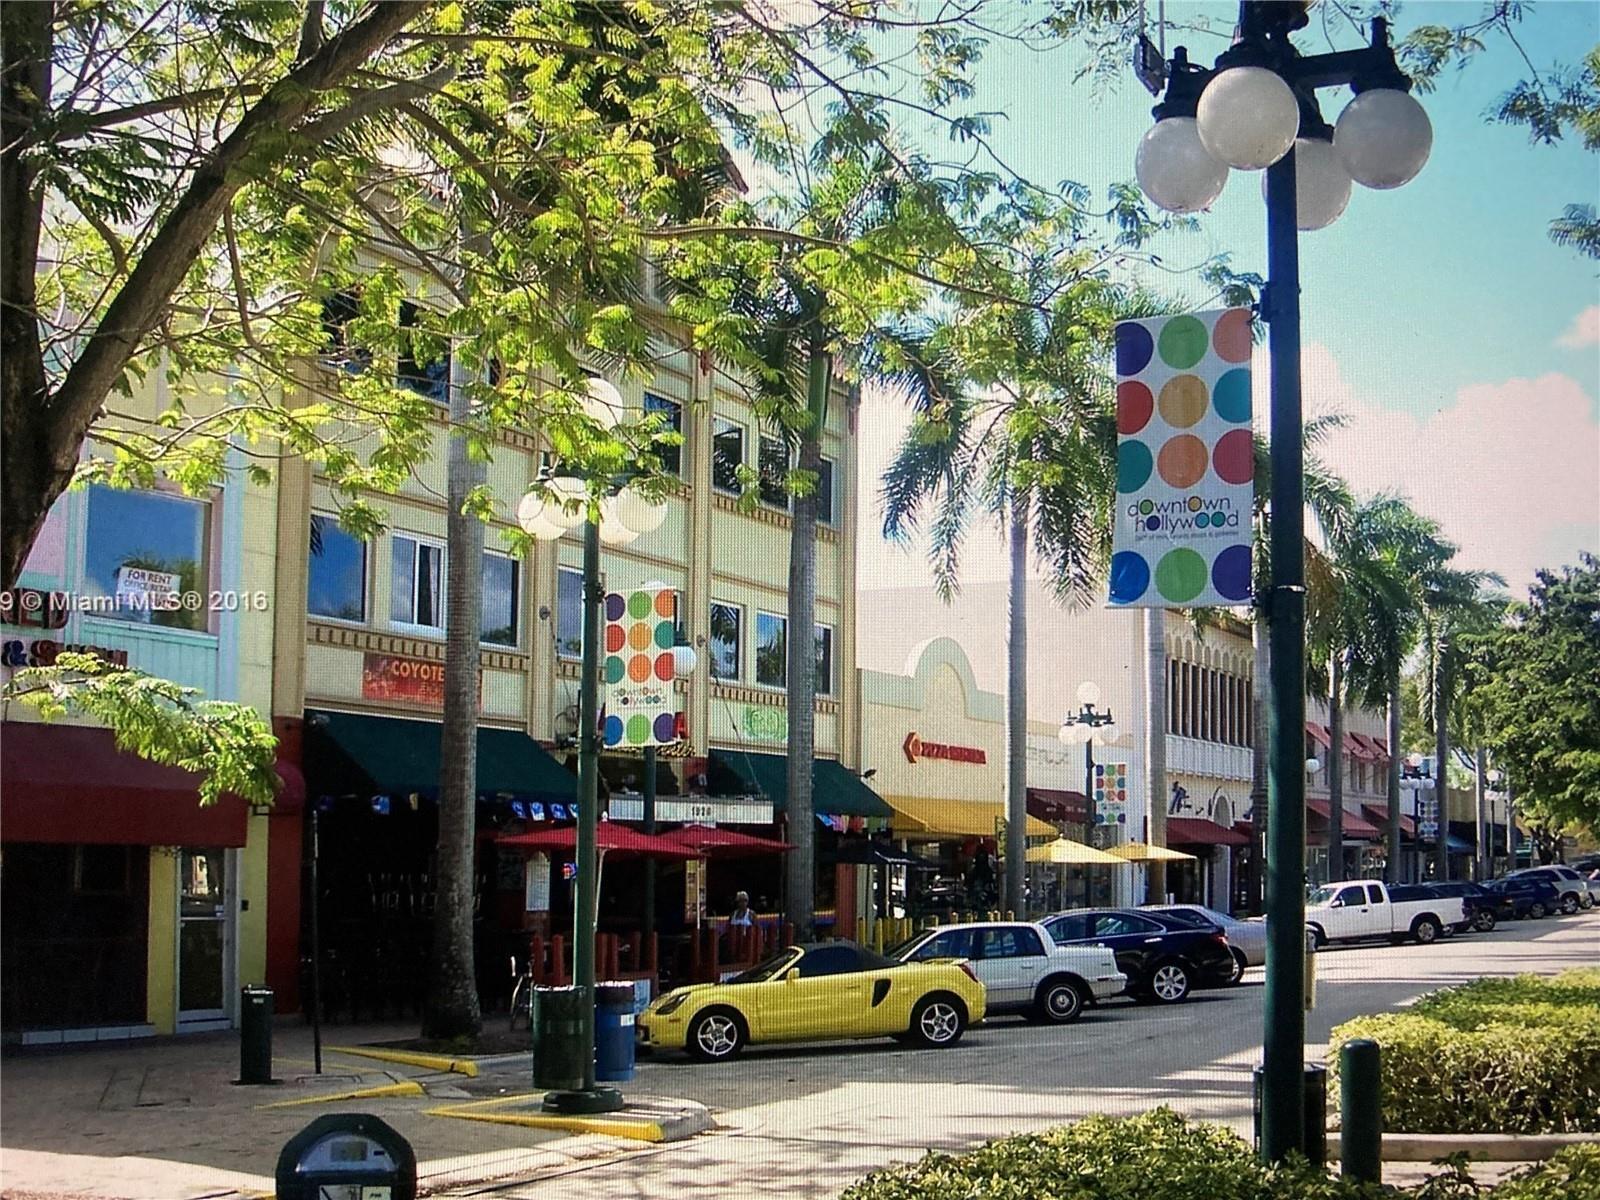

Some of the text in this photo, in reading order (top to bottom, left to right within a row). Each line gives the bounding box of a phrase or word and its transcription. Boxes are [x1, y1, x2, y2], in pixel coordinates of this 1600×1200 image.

[127, 569, 172, 585] FOR RENT
[391, 660, 445, 682] COYOTE
